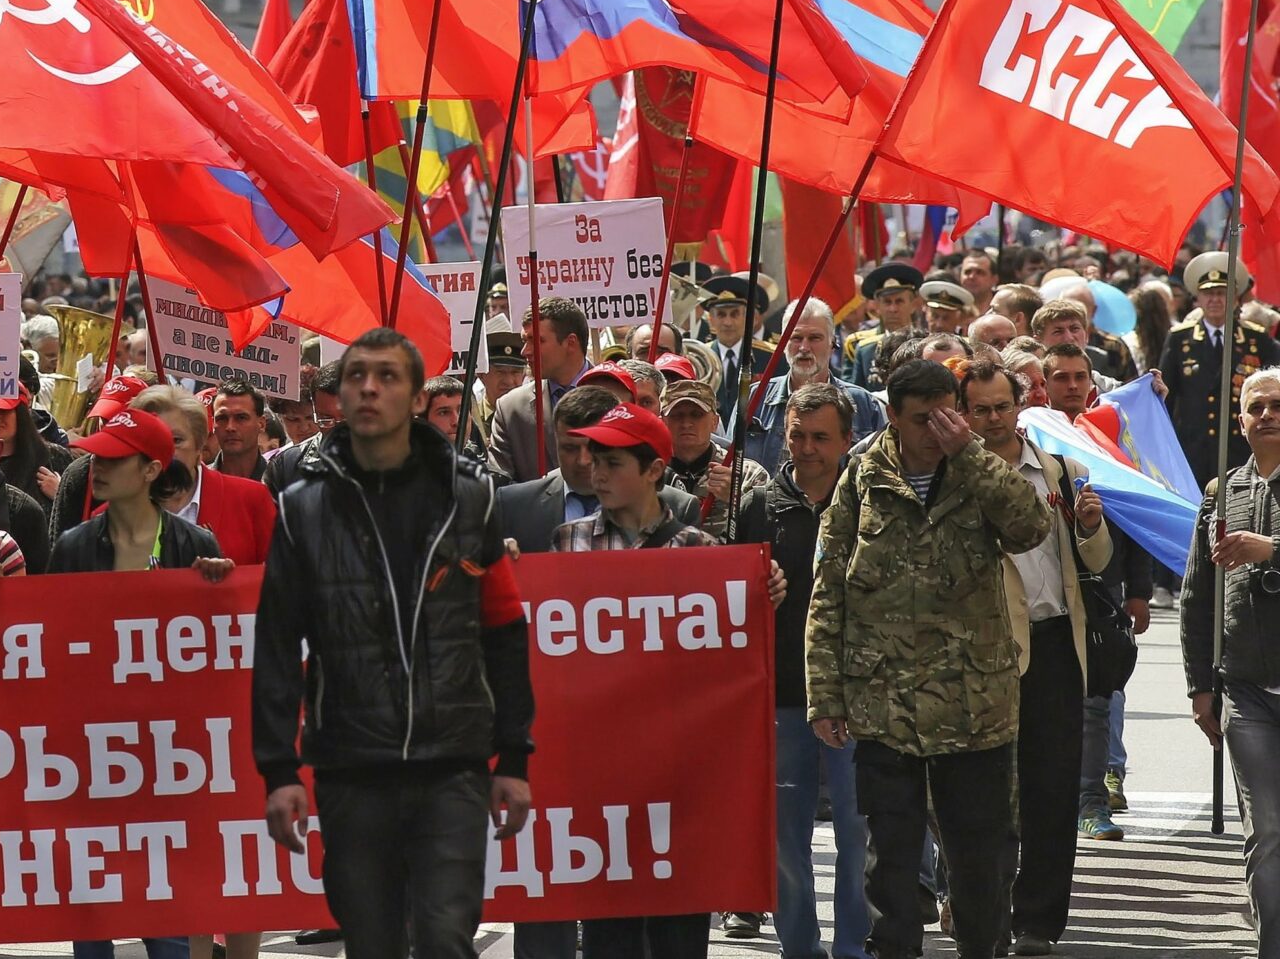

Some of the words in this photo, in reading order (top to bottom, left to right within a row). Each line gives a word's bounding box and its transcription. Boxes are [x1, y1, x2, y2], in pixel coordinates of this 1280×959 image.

[575, 213, 602, 244] За
[516, 256, 615, 290] Украину
[626, 248, 664, 279] без
[172, 328, 186, 346] а
[192, 332, 220, 353] не
[113, 613, 257, 683] ден
[522, 580, 748, 657] еста!
